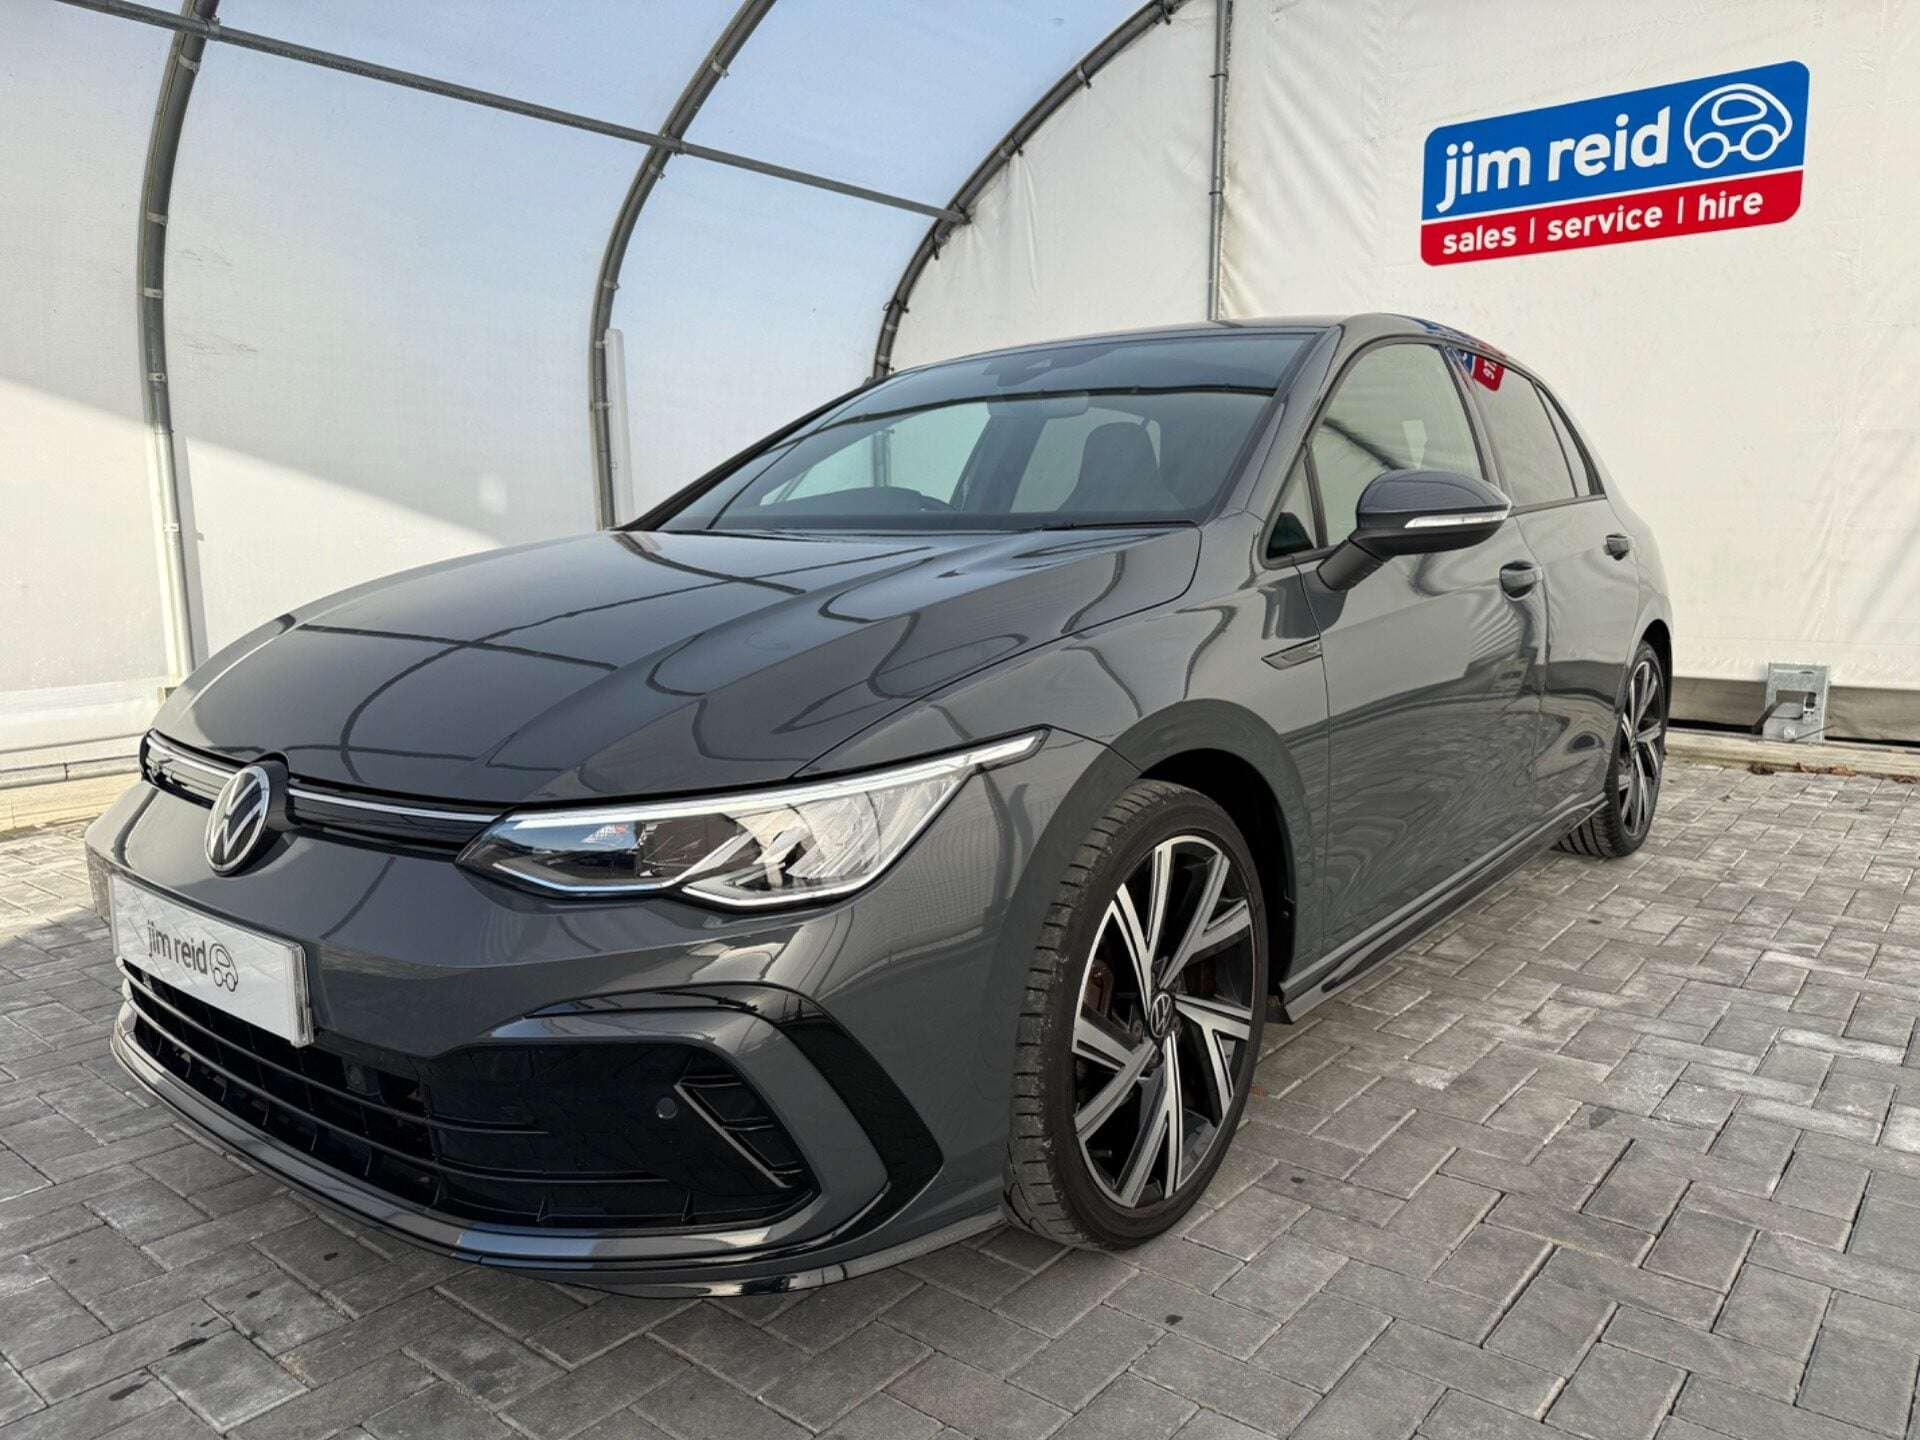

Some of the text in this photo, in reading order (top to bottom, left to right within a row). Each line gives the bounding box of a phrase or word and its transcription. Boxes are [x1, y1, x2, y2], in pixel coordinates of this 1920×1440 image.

[1436, 106, 1671, 214] jim reid
[1442, 190, 1764, 255] sales service hire
[146, 919, 208, 975] jim reid
